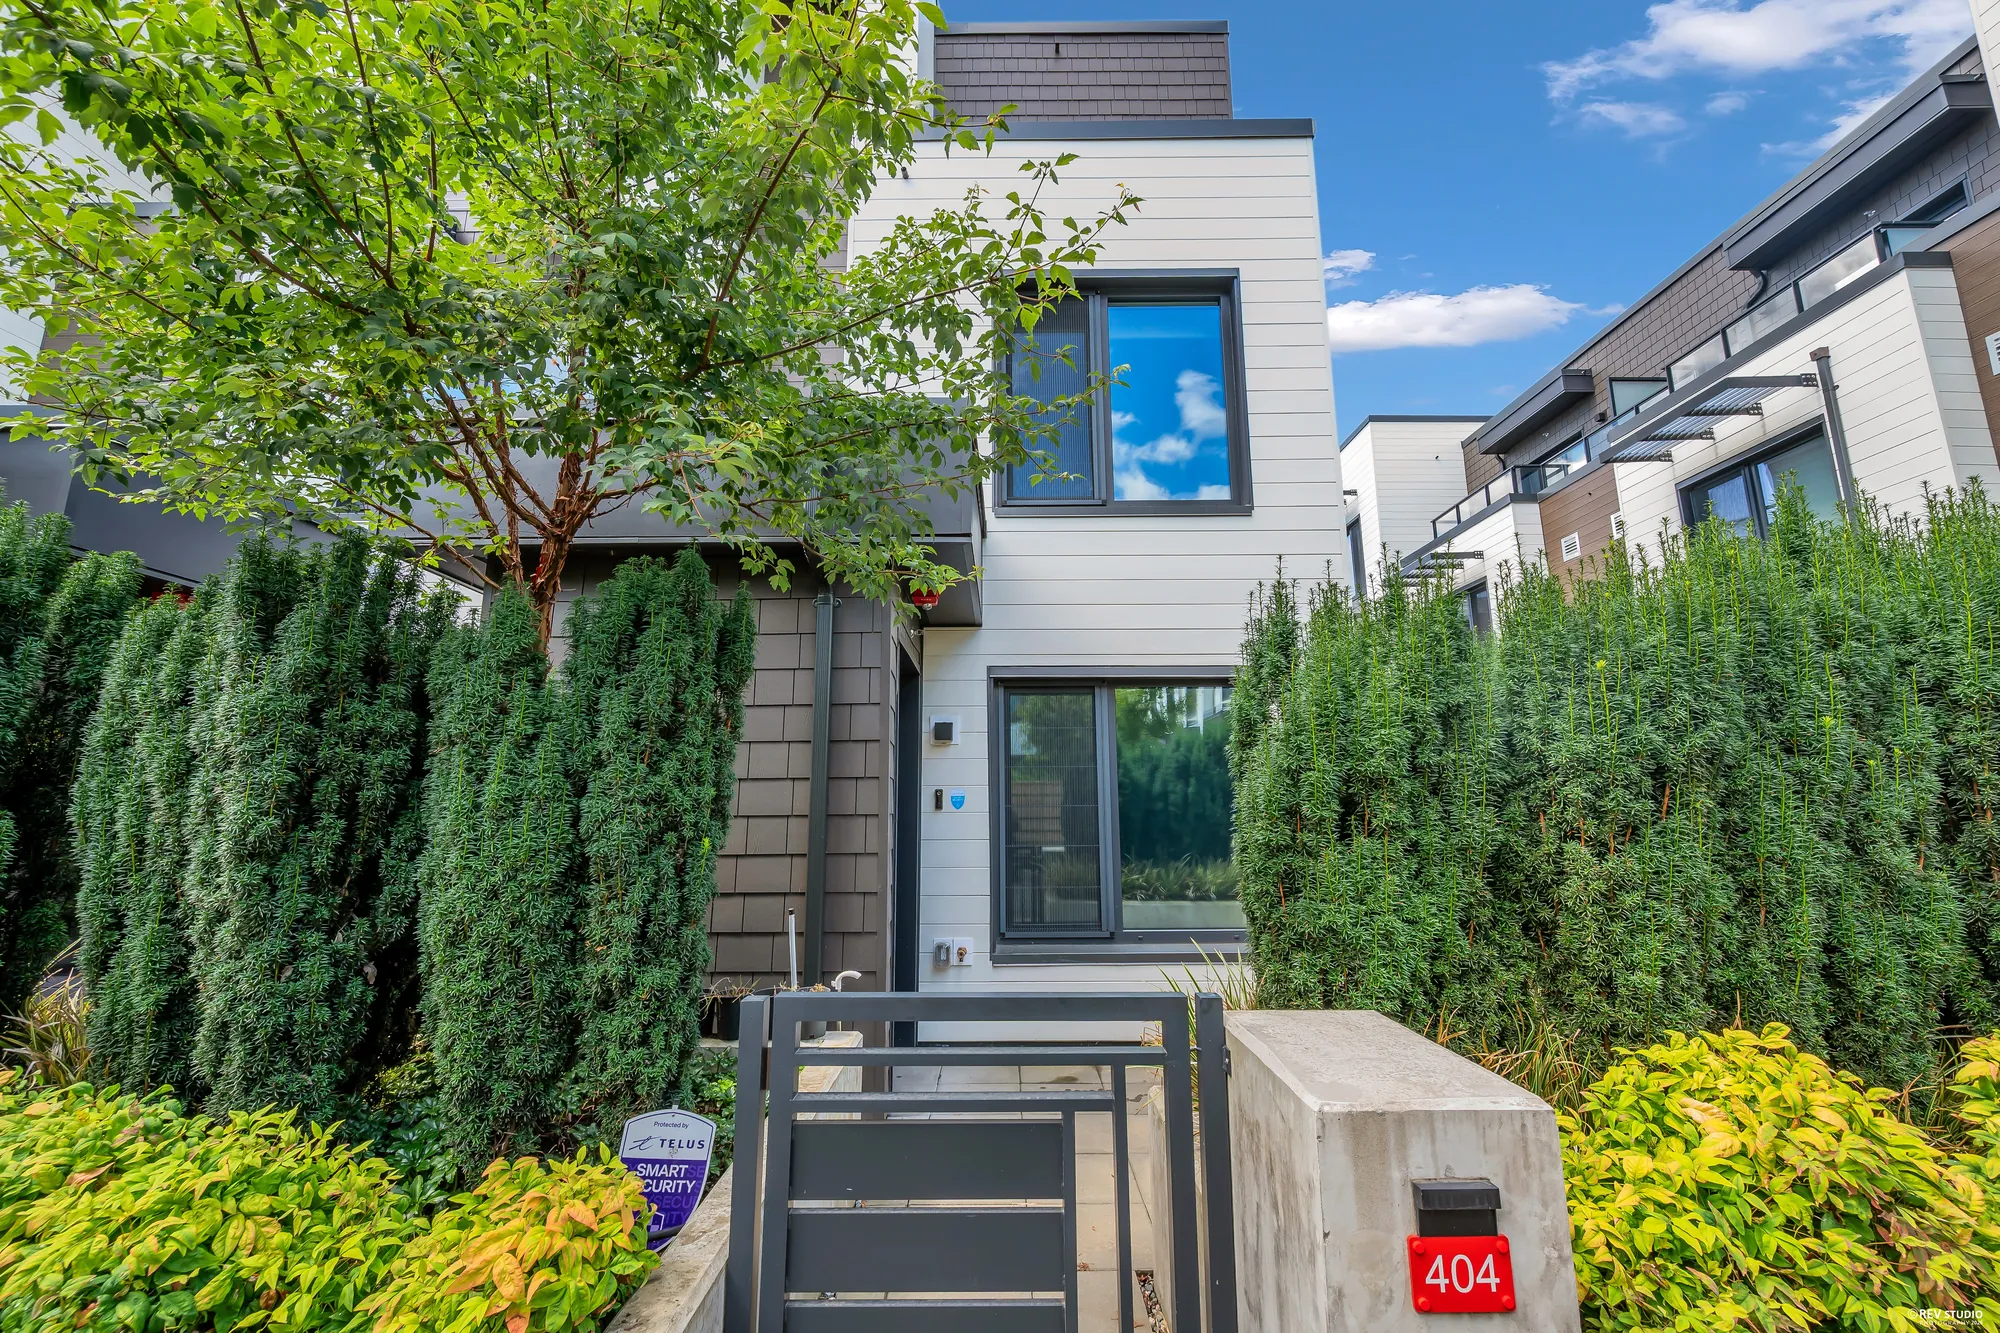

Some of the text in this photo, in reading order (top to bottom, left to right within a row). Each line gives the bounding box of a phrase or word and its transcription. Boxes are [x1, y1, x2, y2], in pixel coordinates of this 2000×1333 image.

[659, 1138, 705, 1150] TELUS
[636, 1163, 689, 1178] SMART
[642, 1179, 696, 1193] CURITY
[1425, 1253, 1500, 1294] 404
